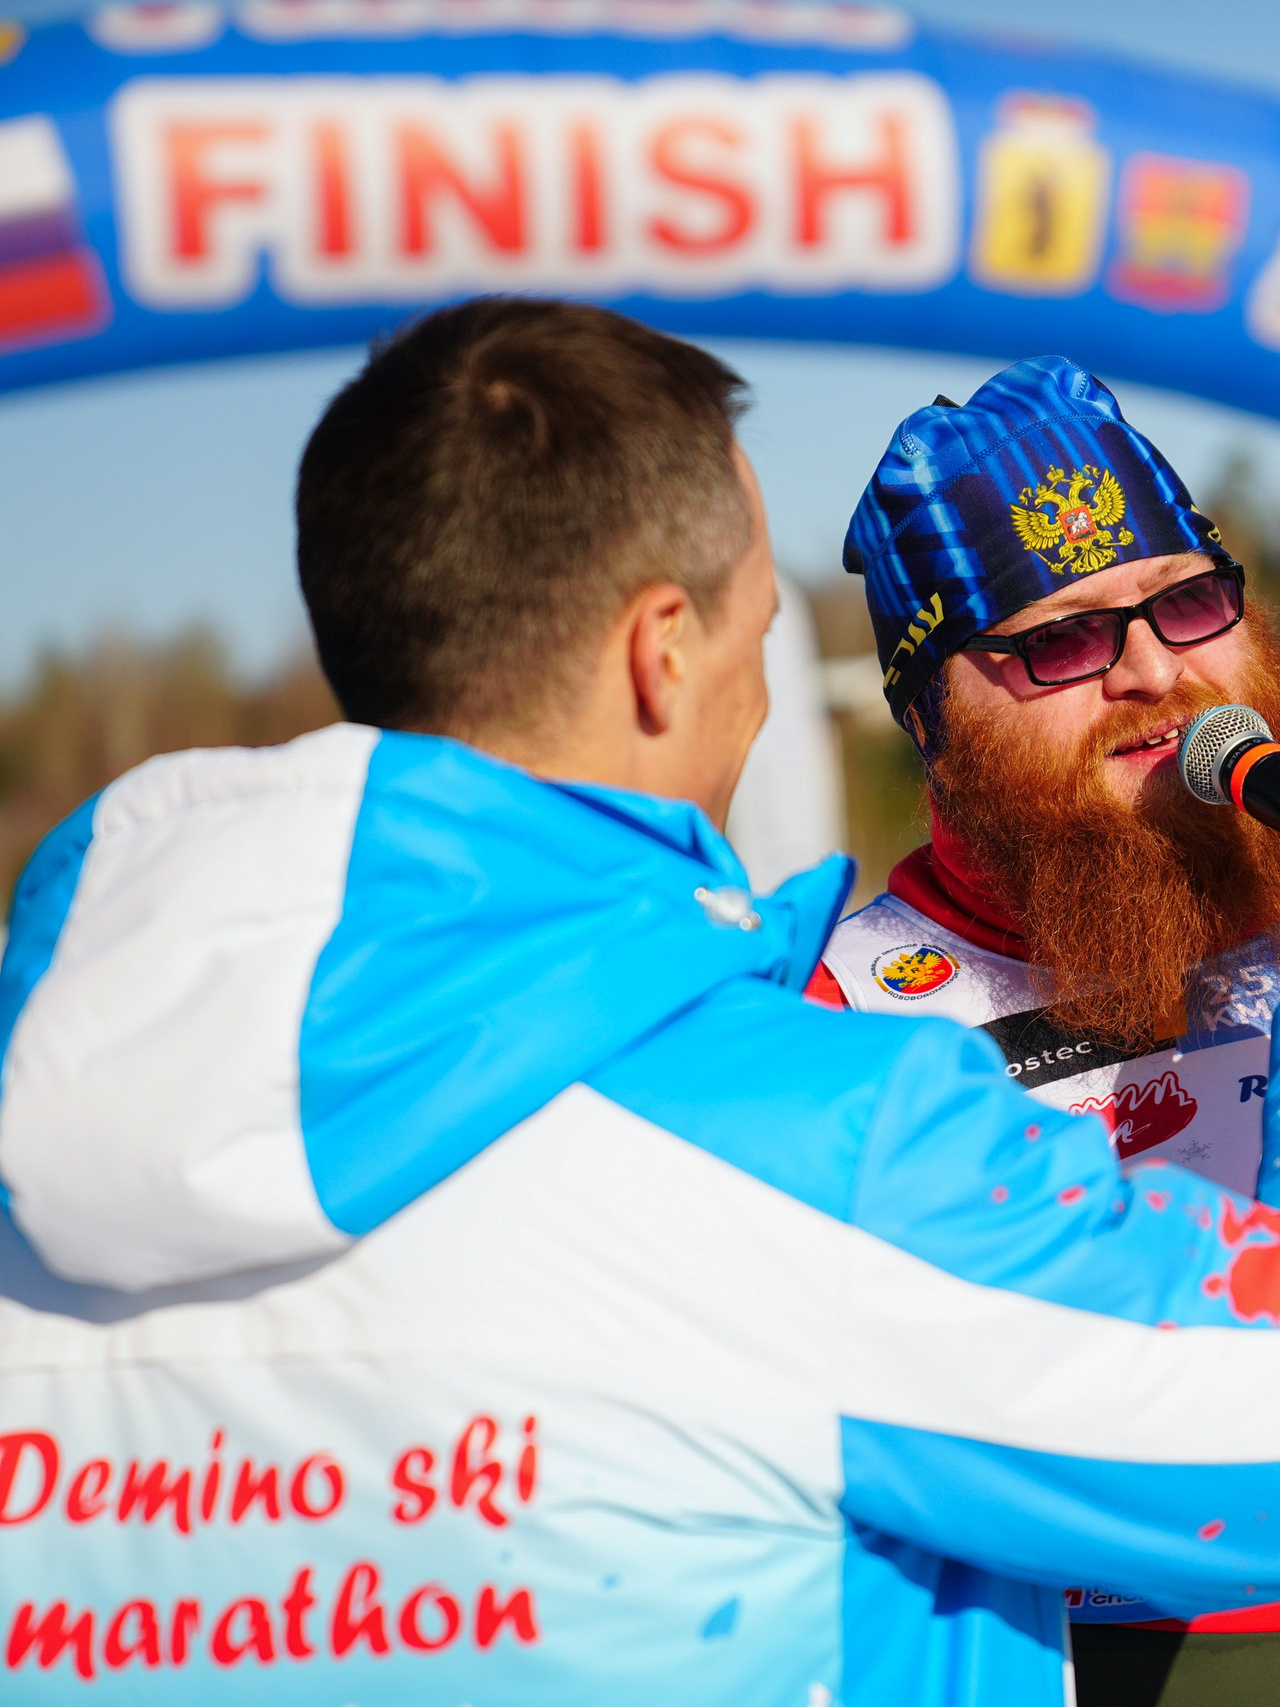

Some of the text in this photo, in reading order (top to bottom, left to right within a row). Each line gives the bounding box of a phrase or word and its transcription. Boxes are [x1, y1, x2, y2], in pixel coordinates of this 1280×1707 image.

[160, 110, 920, 265] FINISH
[887, 970, 960, 1001] ROSOBORONEXPORT
[922, 943, 949, 955] EXPORT
[1004, 1041, 1094, 1077] ostec
[0, 1414, 537, 1536] Demino ski
[6, 1560, 540, 1682] marathon
